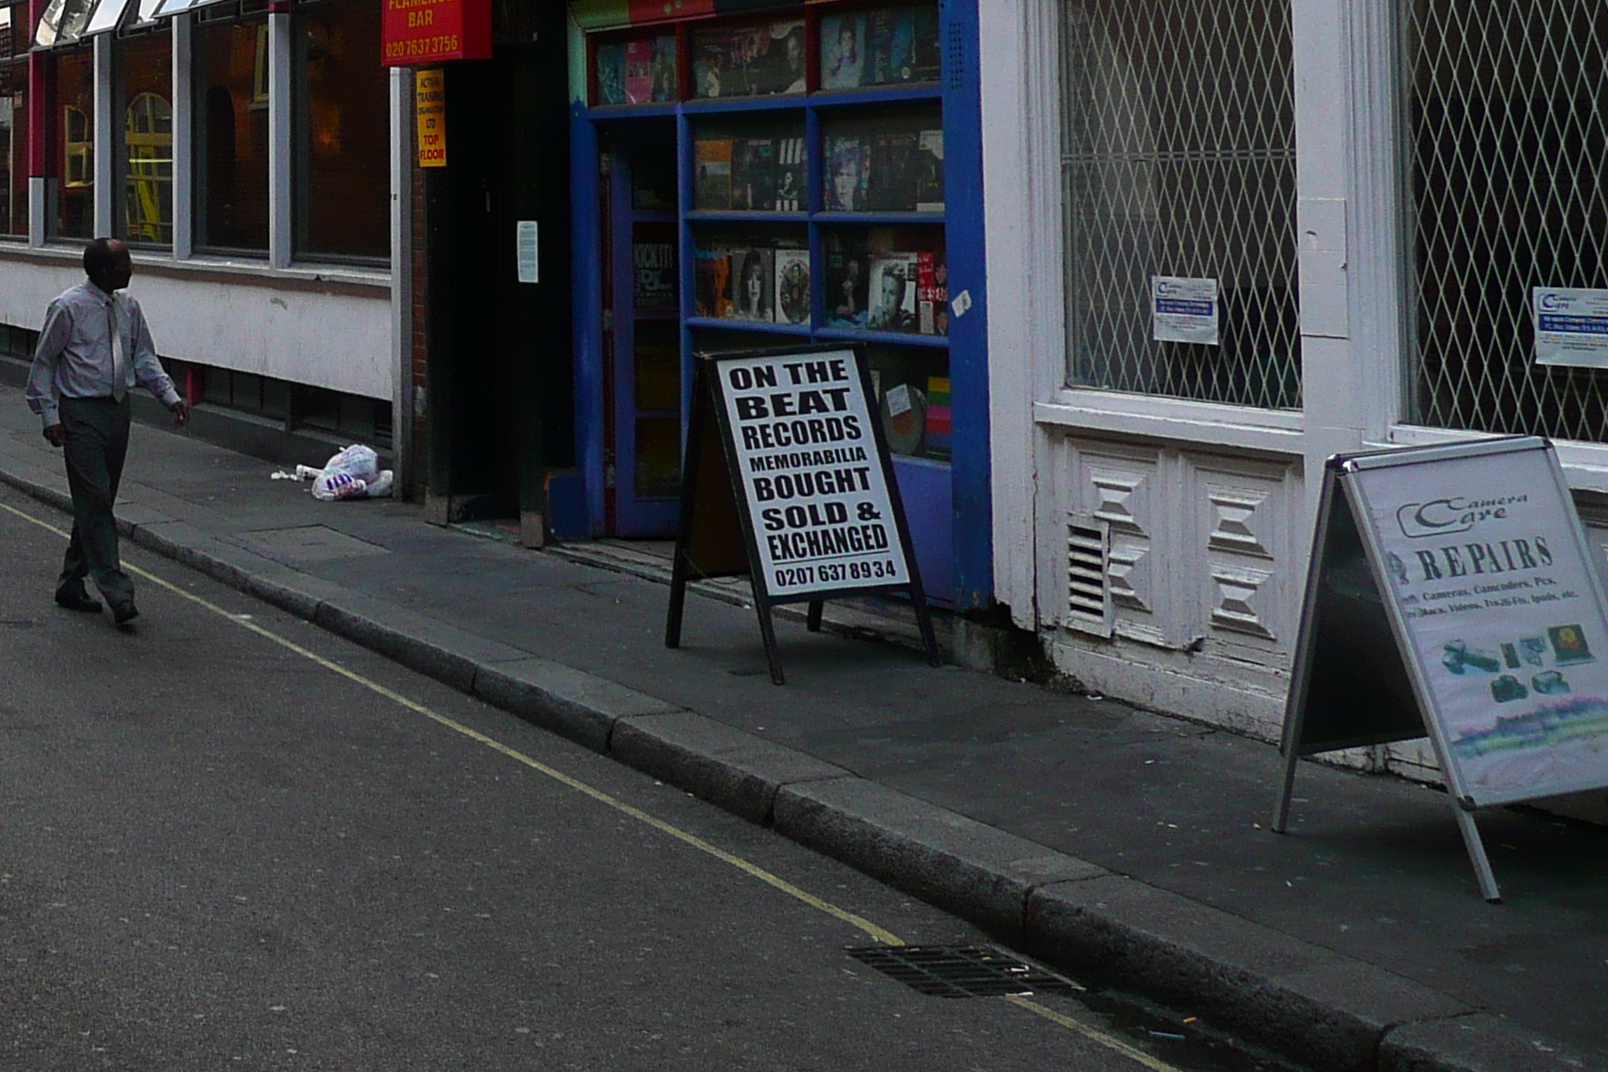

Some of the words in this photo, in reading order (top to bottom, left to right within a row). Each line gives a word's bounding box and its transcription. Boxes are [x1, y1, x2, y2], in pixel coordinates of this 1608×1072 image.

[408, 9, 433, 28] BAR
[386, 40, 404, 58] 020
[406, 37, 430, 56] 7637
[432, 34, 458, 54] 3756
[420, 149, 444, 160] FLOOR
[423, 134, 439, 146] TOP
[729, 365, 777, 391] ON
[783, 359, 849, 384] THE
[735, 388, 851, 421] BEAT
[741, 415, 862, 451] RECORDS
[749, 446, 868, 473] MEMORABILIA
[753, 467, 870, 502] BOUGHT
[762, 502, 848, 532] SOLD
[857, 501, 881, 522] &
[1414, 499, 1508, 528] Care
[1448, 494, 1529, 511] Camera
[767, 523, 888, 561] EXCHANGED
[1414, 535, 1554, 581] REPAIRS
[775, 565, 814, 588] 0207
[819, 563, 847, 583] 637
[850, 559, 896, 580] 8934
